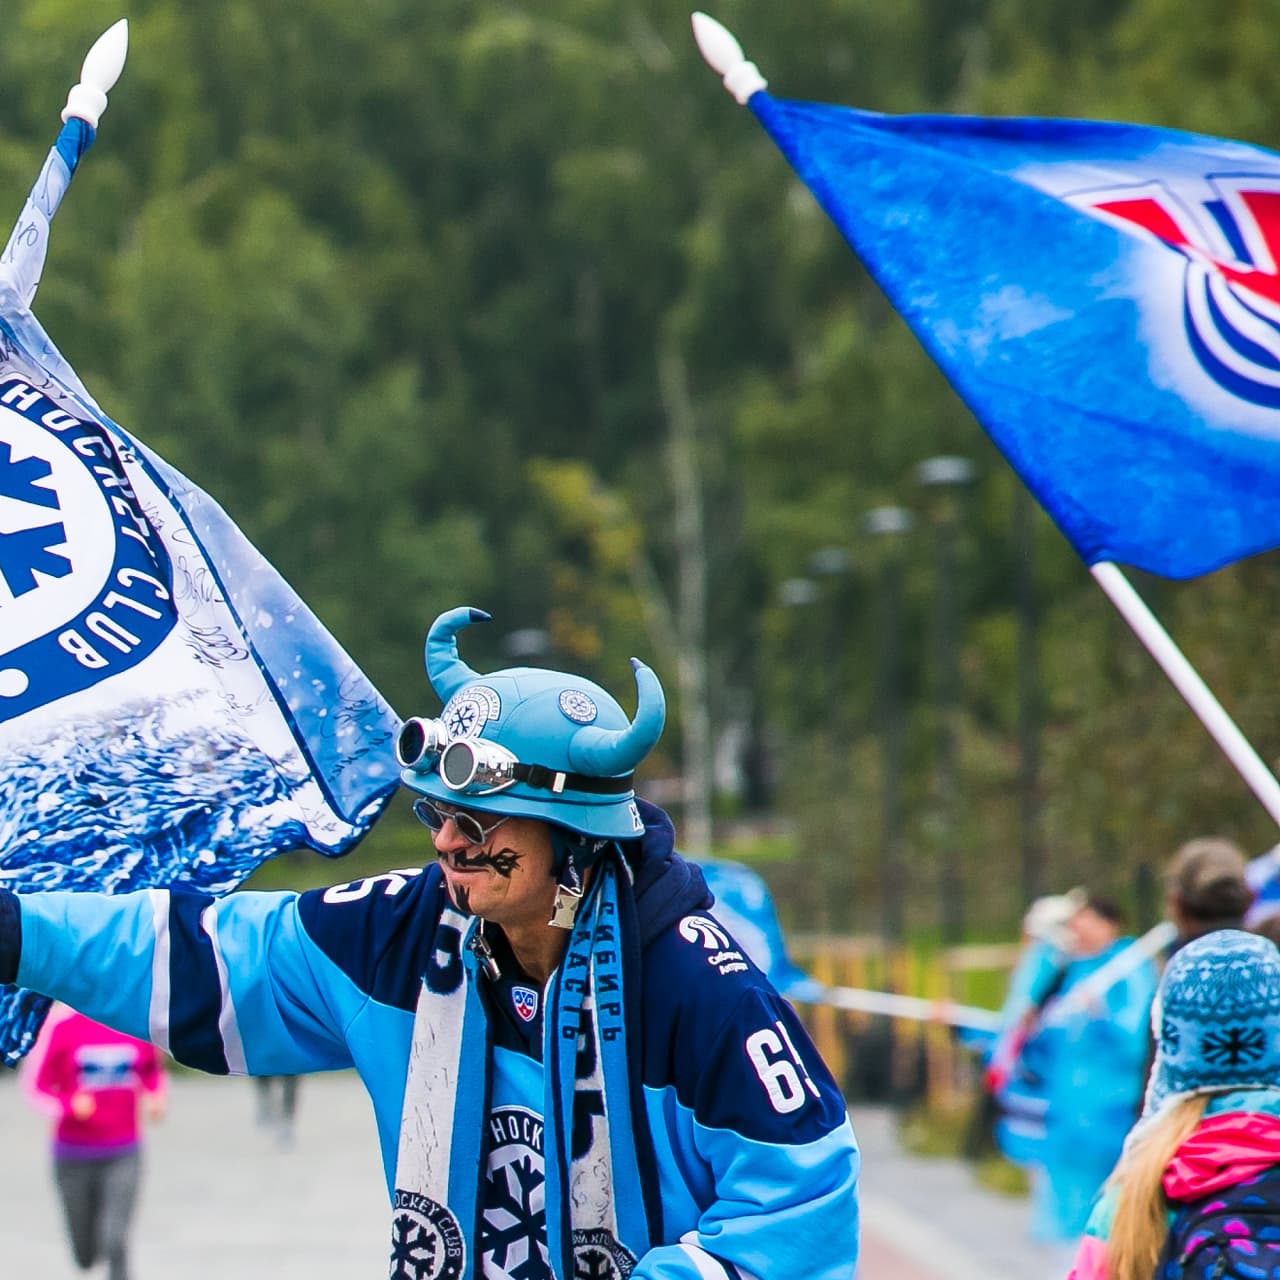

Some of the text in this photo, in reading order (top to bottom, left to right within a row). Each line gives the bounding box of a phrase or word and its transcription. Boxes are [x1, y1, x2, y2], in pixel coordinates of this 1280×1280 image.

[57, 567, 170, 669] CLUB
[593, 902, 622, 1042] СИБИРЬ
[438, 1217, 462, 1257] CLUB
